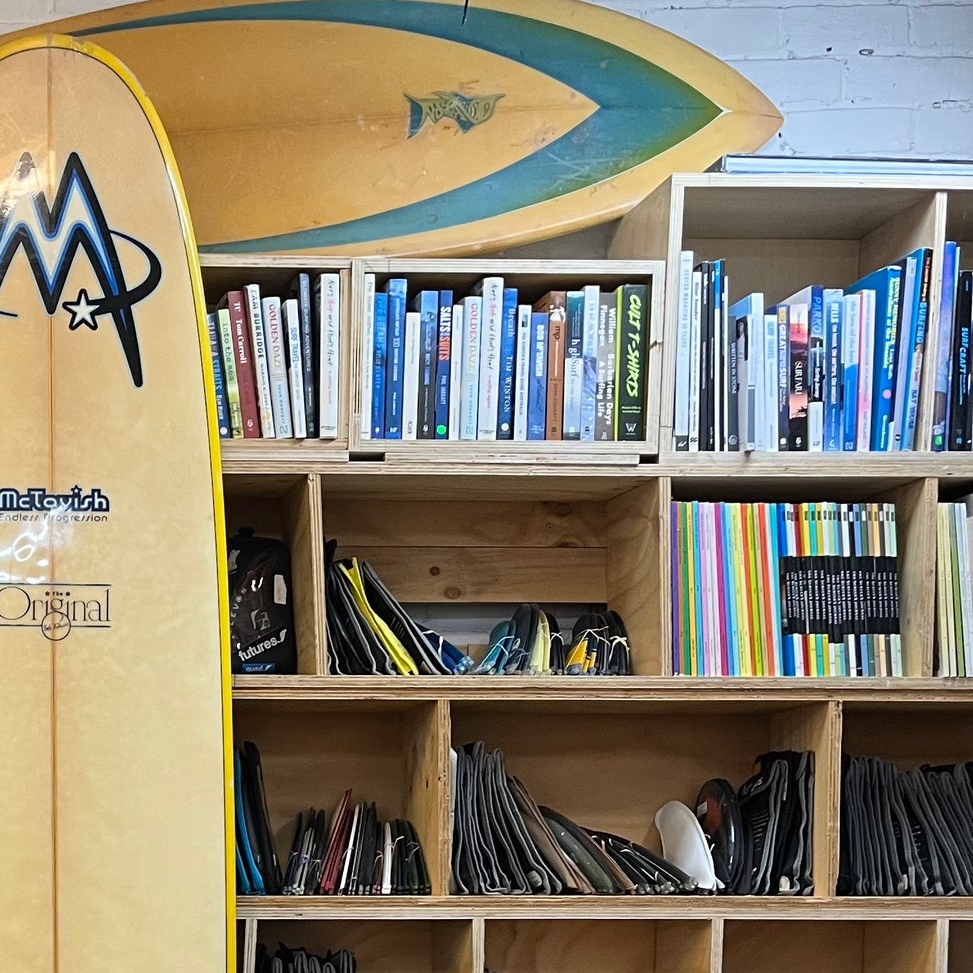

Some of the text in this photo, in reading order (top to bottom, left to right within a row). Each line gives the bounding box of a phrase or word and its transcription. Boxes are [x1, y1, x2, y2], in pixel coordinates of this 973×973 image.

[235, 319, 243, 335] Tom
[598, 304, 608, 347] Finnegan
[608, 307, 617, 343] William
[627, 294, 641, 331] CULT
[812, 296, 822, 333] PARKO
[916, 302, 928, 343] SURFING
[253, 313, 265, 359] BURRIDGE
[269, 303, 282, 370] GOLDEN DAZE
[290, 327, 298, 341] SURF
[376, 316, 386, 348] DREAMS
[438, 306, 452, 361] SALTS SUITS
[468, 303, 478, 371] GOLDEN DAZE
[536, 324, 545, 341] BOB
[552, 325, 561, 340] mp
[779, 324, 787, 350] GREAT
[223, 321, 235, 382] into the sea
[237, 336, 247, 364] Carroll
[291, 343, 300, 363] TRAVEL
[504, 308, 516, 413] Breath TIM WINTON
[626, 332, 640, 397] T-SHIRTS
[959, 347, 967, 374] CRAFT
[596, 368, 606, 399] Surfing
[604, 354, 615, 425] Barbarian Days
[778, 368, 787, 389] SURF
[794, 361, 803, 395] SURFARI
[597, 402, 606, 417] Life
[238, 637, 282, 661] futures.
